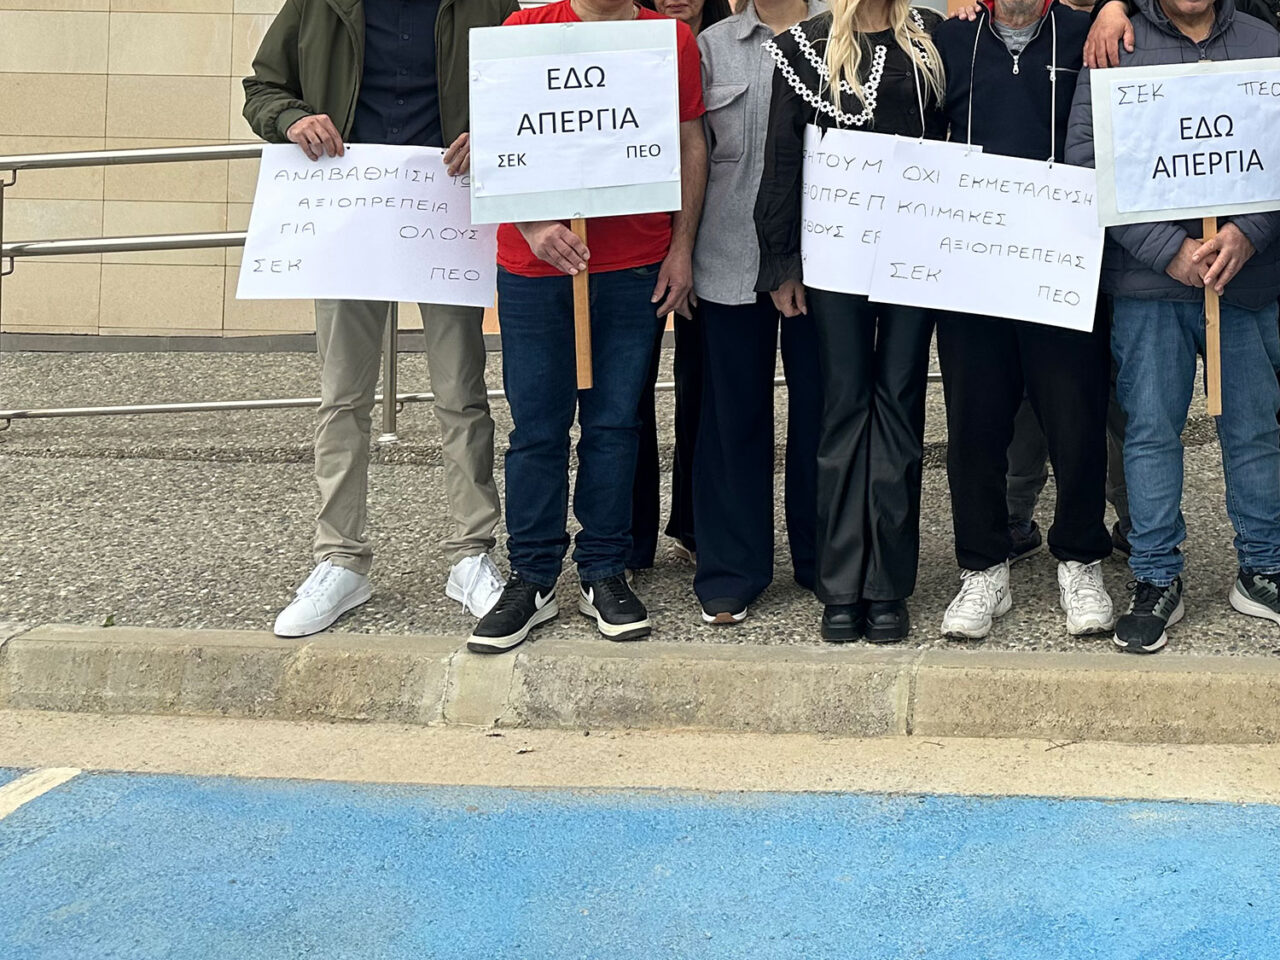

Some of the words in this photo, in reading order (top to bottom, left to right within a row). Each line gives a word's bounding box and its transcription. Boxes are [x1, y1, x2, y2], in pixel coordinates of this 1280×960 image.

[546, 65, 607, 91] ΕΔΩ
[1117, 83, 1165, 105] ΣΕΚ
[516, 107, 640, 137] ΑΠΕΡΓΙΑ
[1179, 114, 1234, 140] ΕΔΩ
[497, 152, 527, 168] ΣΕΚ
[625, 142, 661, 159] ΠΕΟ
[1152, 148, 1265, 179] ΑΠΕΡΓΙΑ
[274, 166, 435, 184] ΑΝΑΒΑΘΜΙΣΗ
[902, 165, 940, 183] ΟΧΙ
[959, 174, 1093, 206] ΕΚΜΕΤΑΛΕΥΣΗ
[298, 196, 449, 215] ΑΞΙΟΠΡΕΠΕΙΑ
[897, 200, 1007, 227] ΚΛΙΜΑΚΕΣ
[280, 221, 316, 236] ΓΙΑ
[399, 224, 479, 241] ΟΛΟΥΣ
[939, 237, 1087, 270] ΑΞΙΟΠΡΕΠΕΙΑΣ
[252, 257, 303, 273] ΣΕΚ
[429, 266, 481, 282] ΠΕΟ
[890, 262, 942, 283] ΣΕΚ
[1038, 285, 1081, 307] ΠΕΟ
